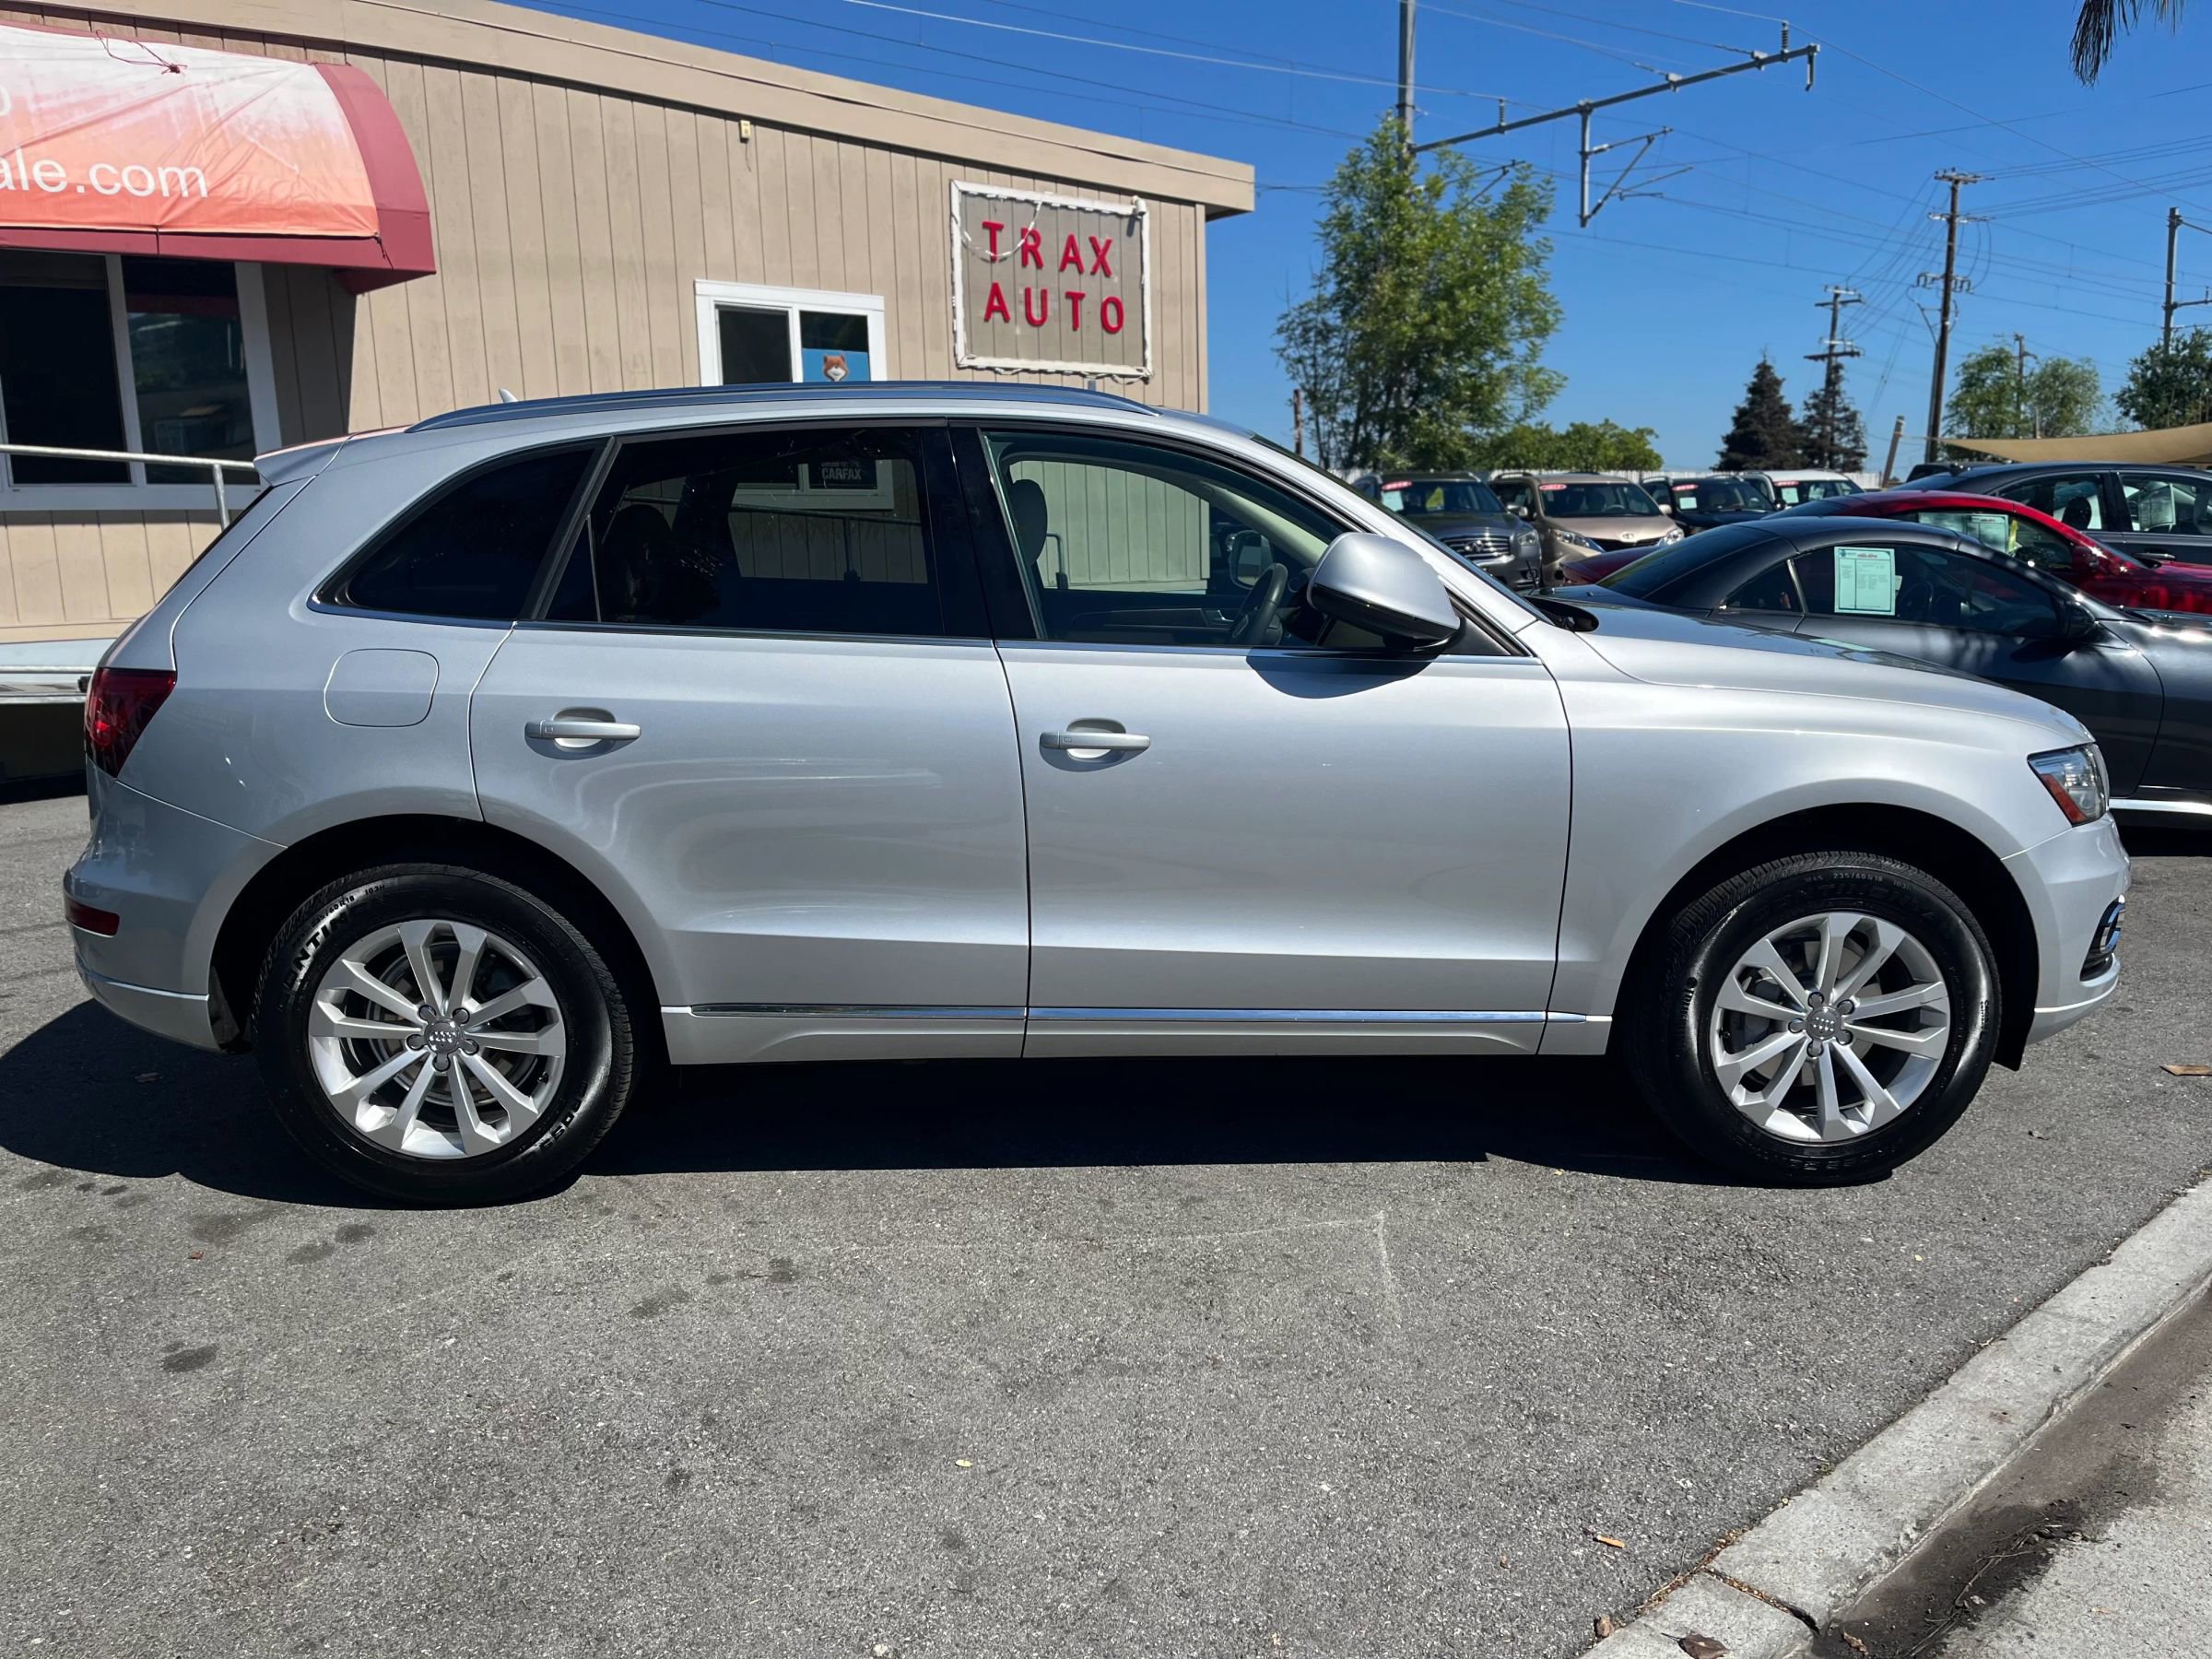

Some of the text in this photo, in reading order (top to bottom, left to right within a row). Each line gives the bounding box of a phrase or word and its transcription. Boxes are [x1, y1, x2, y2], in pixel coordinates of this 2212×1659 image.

[982, 220, 1112, 277] TRAX
[983, 281, 1124, 334] AUTO
[821, 468, 862, 480] CARFAX
